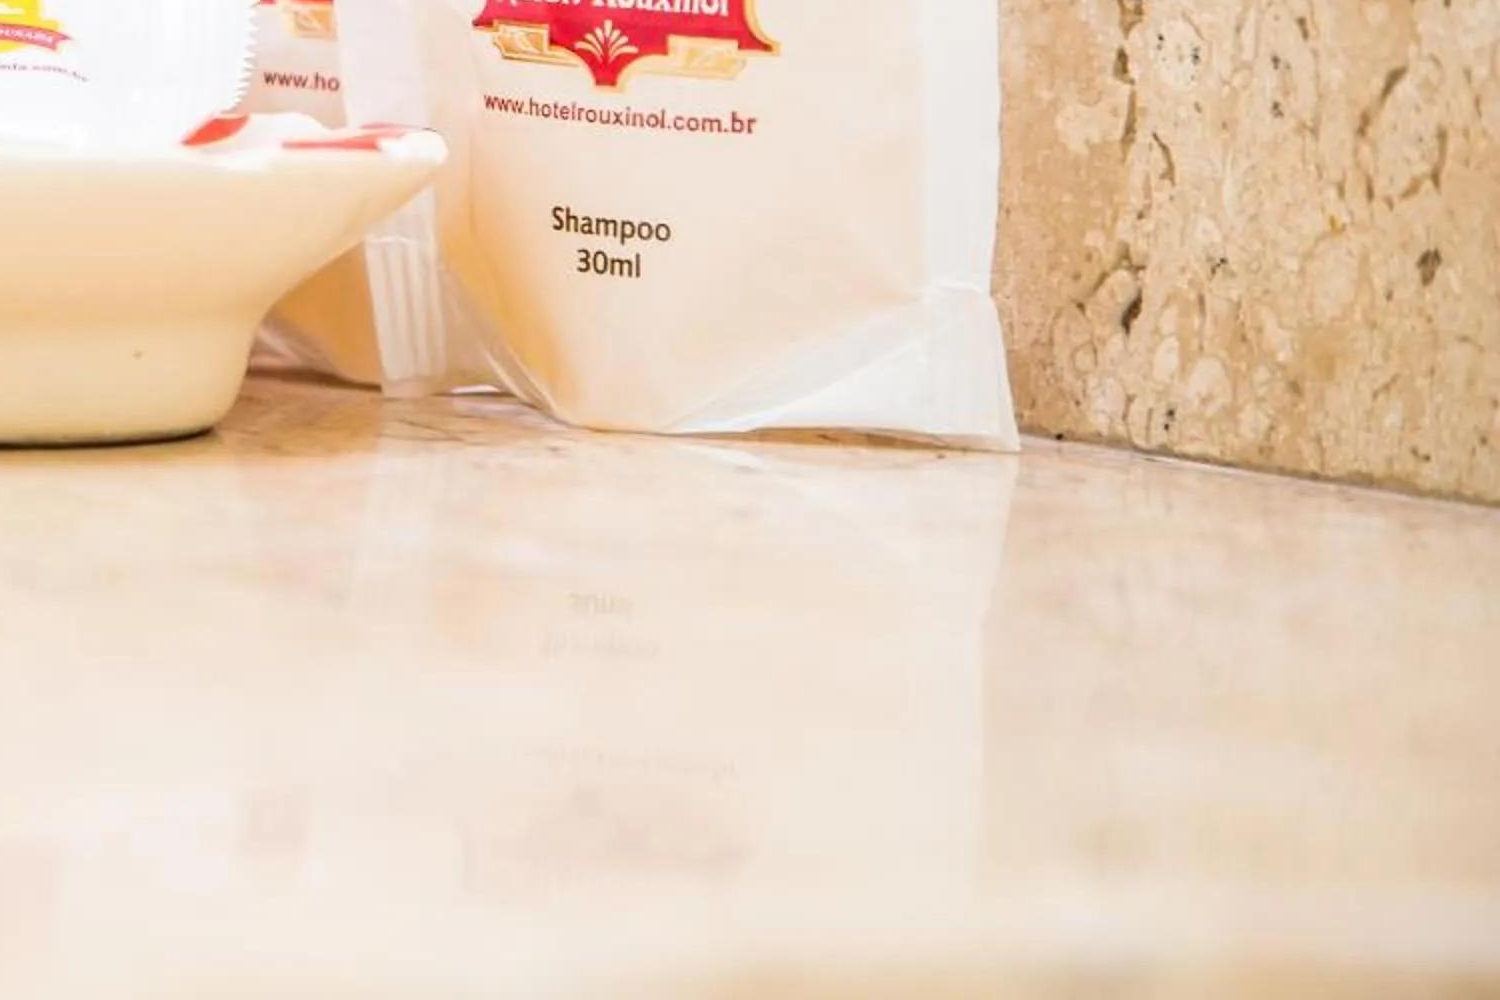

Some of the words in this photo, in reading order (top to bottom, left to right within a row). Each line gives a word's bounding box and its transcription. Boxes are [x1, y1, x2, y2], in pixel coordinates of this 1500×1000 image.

[483, 92, 757, 135] www.hotelrouxinol.com.br
[551, 206, 672, 244] Shampoo
[576, 248, 642, 279] 30ml
